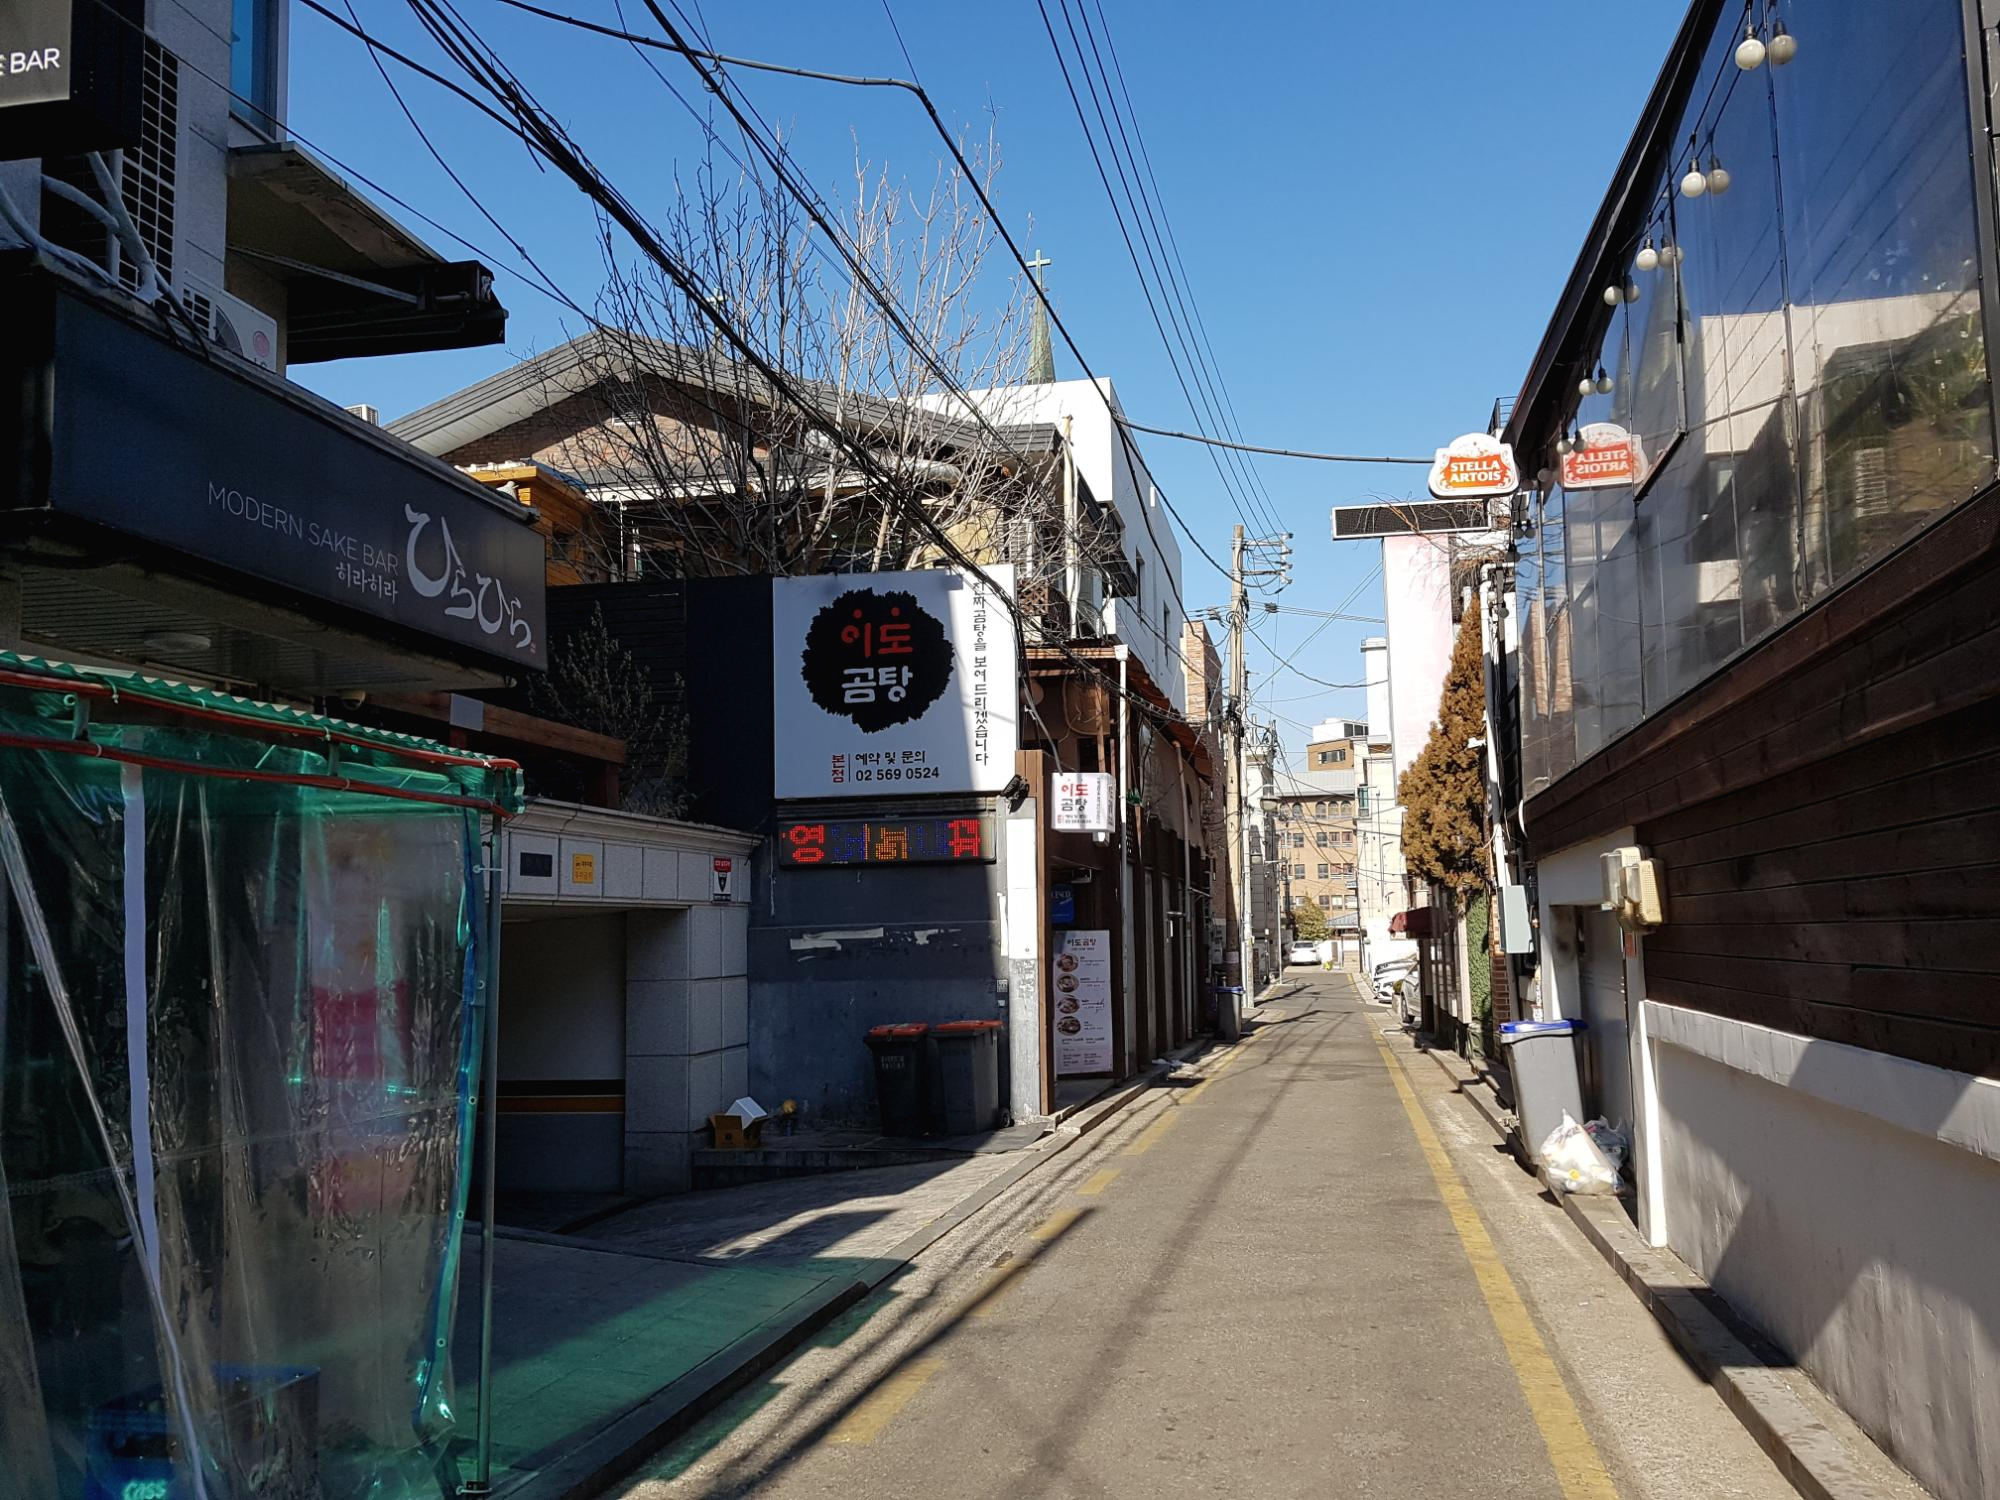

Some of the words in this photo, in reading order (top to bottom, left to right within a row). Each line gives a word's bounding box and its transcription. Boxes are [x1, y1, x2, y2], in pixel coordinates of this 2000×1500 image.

[10, 47, 60, 74] BAR
[1450, 460, 1501, 473] STELLA
[1450, 471, 1501, 483] ARTOIS
[208, 478, 303, 540] MODERN
[308, 522, 358, 562] SAKE
[362, 544, 399, 575] BAR
[335, 562, 399, 604] 히라히라
[841, 621, 914, 658] 이도
[841, 665, 914, 704] 곰탕
[974, 656, 989, 766] 보여드리겠습니다
[832, 754, 845, 783] 본점
[855, 752, 881, 766] 예약
[884, 751, 896, 765] 및
[901, 750, 926, 764] 문의
[855, 769, 872, 782] 02
[876, 768, 902, 781] 569
[905, 766, 940, 780] 0524
[1061, 783, 1089, 797] 이도
[1061, 798, 1088, 811] 곰탕
